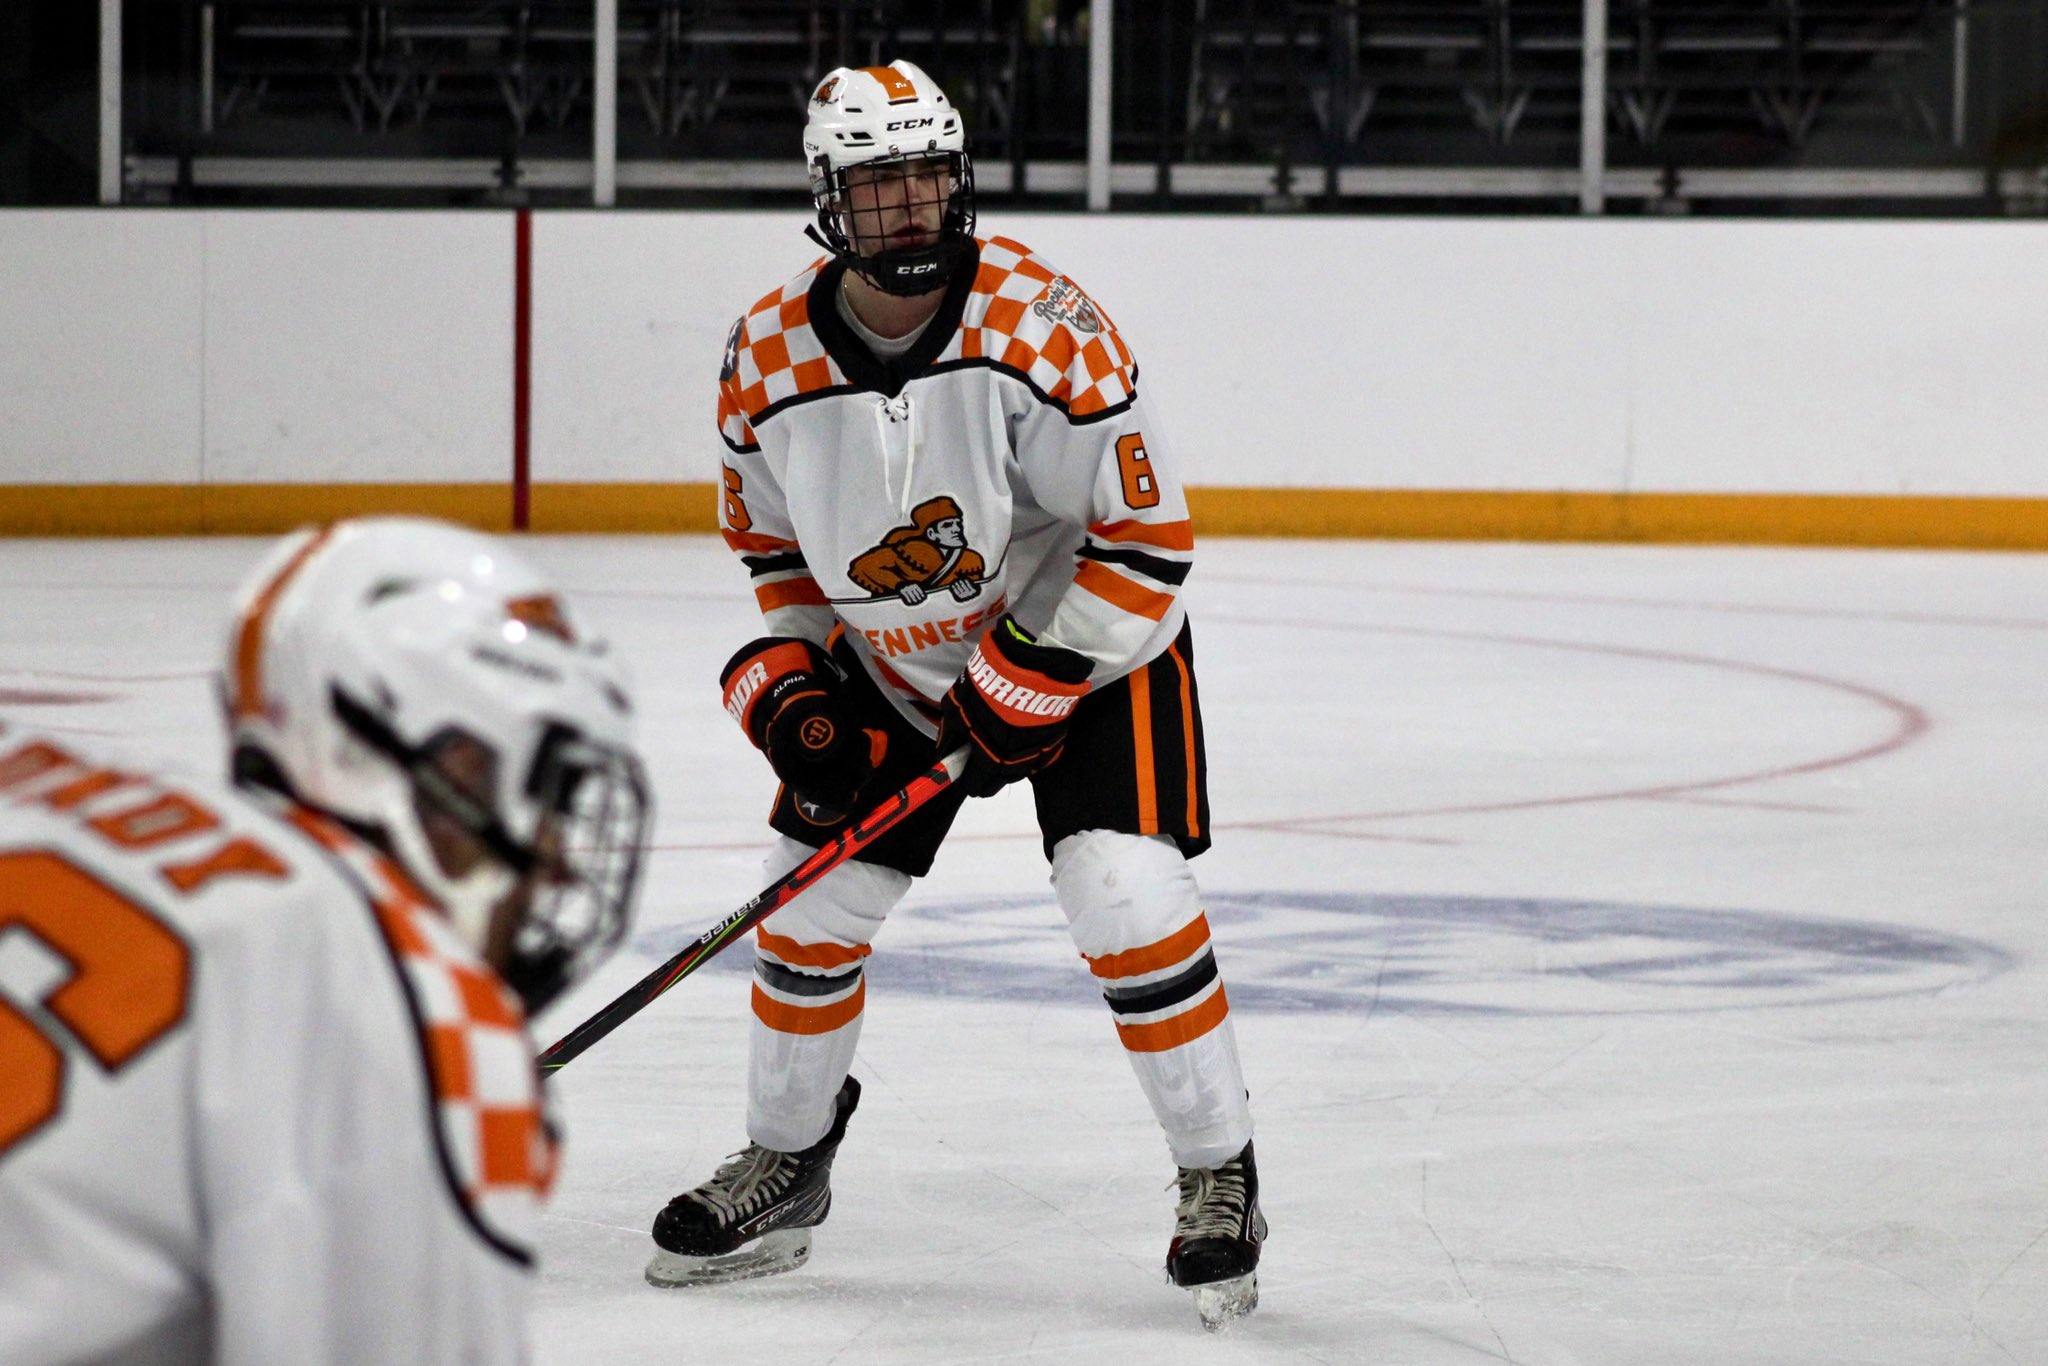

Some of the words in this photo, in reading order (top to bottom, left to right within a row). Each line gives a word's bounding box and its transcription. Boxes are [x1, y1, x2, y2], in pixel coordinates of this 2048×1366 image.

[886, 117, 934, 132] CCM
[896, 262, 938, 275] CCM
[1115, 431, 1160, 510] 6
[773, 675, 806, 698] ALPHA
[967, 644, 1080, 717] WARRIOR
[701, 896, 761, 944] BAUER
[756, 1200, 796, 1233] CCM
